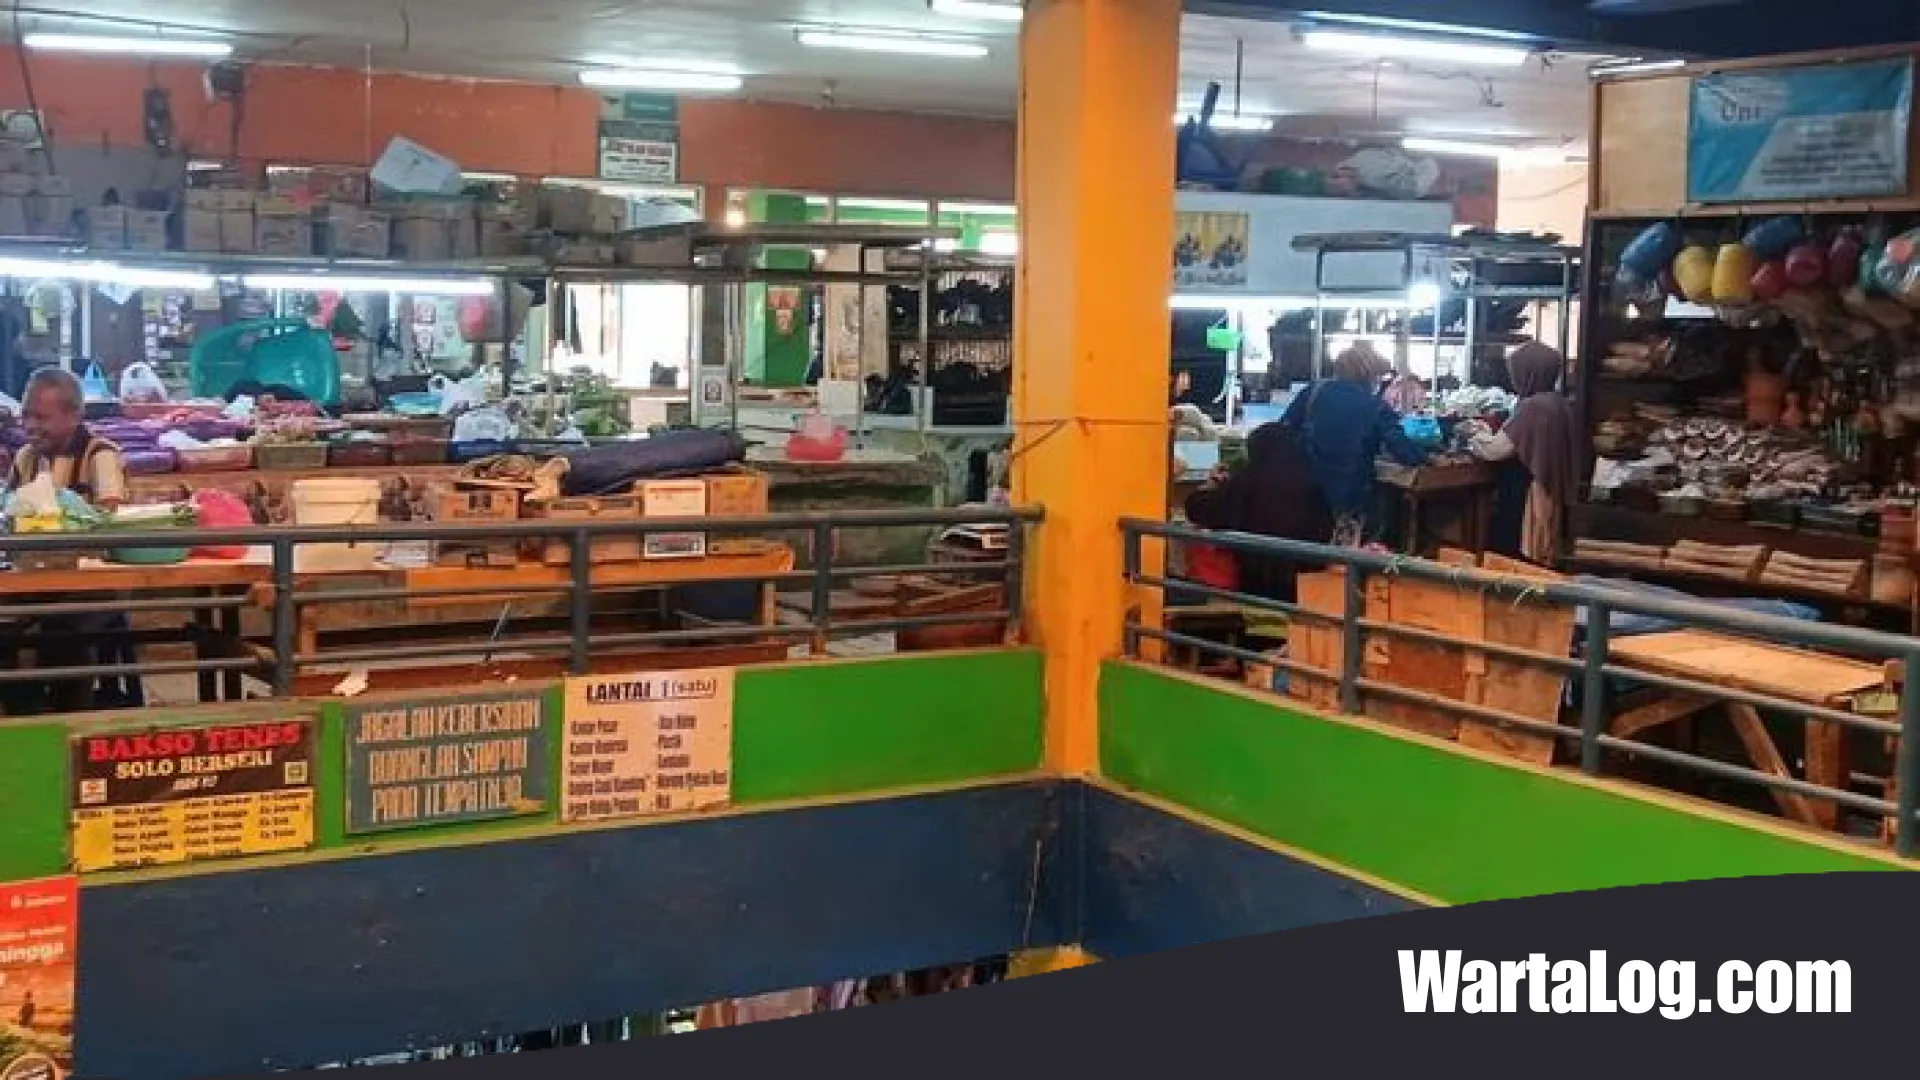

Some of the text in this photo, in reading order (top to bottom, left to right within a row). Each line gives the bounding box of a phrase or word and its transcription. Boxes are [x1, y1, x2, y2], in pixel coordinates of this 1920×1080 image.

[586, 681, 651, 700] LANTAI
[88, 733, 195, 760] BAKSO
[116, 758, 174, 779] SOLO
